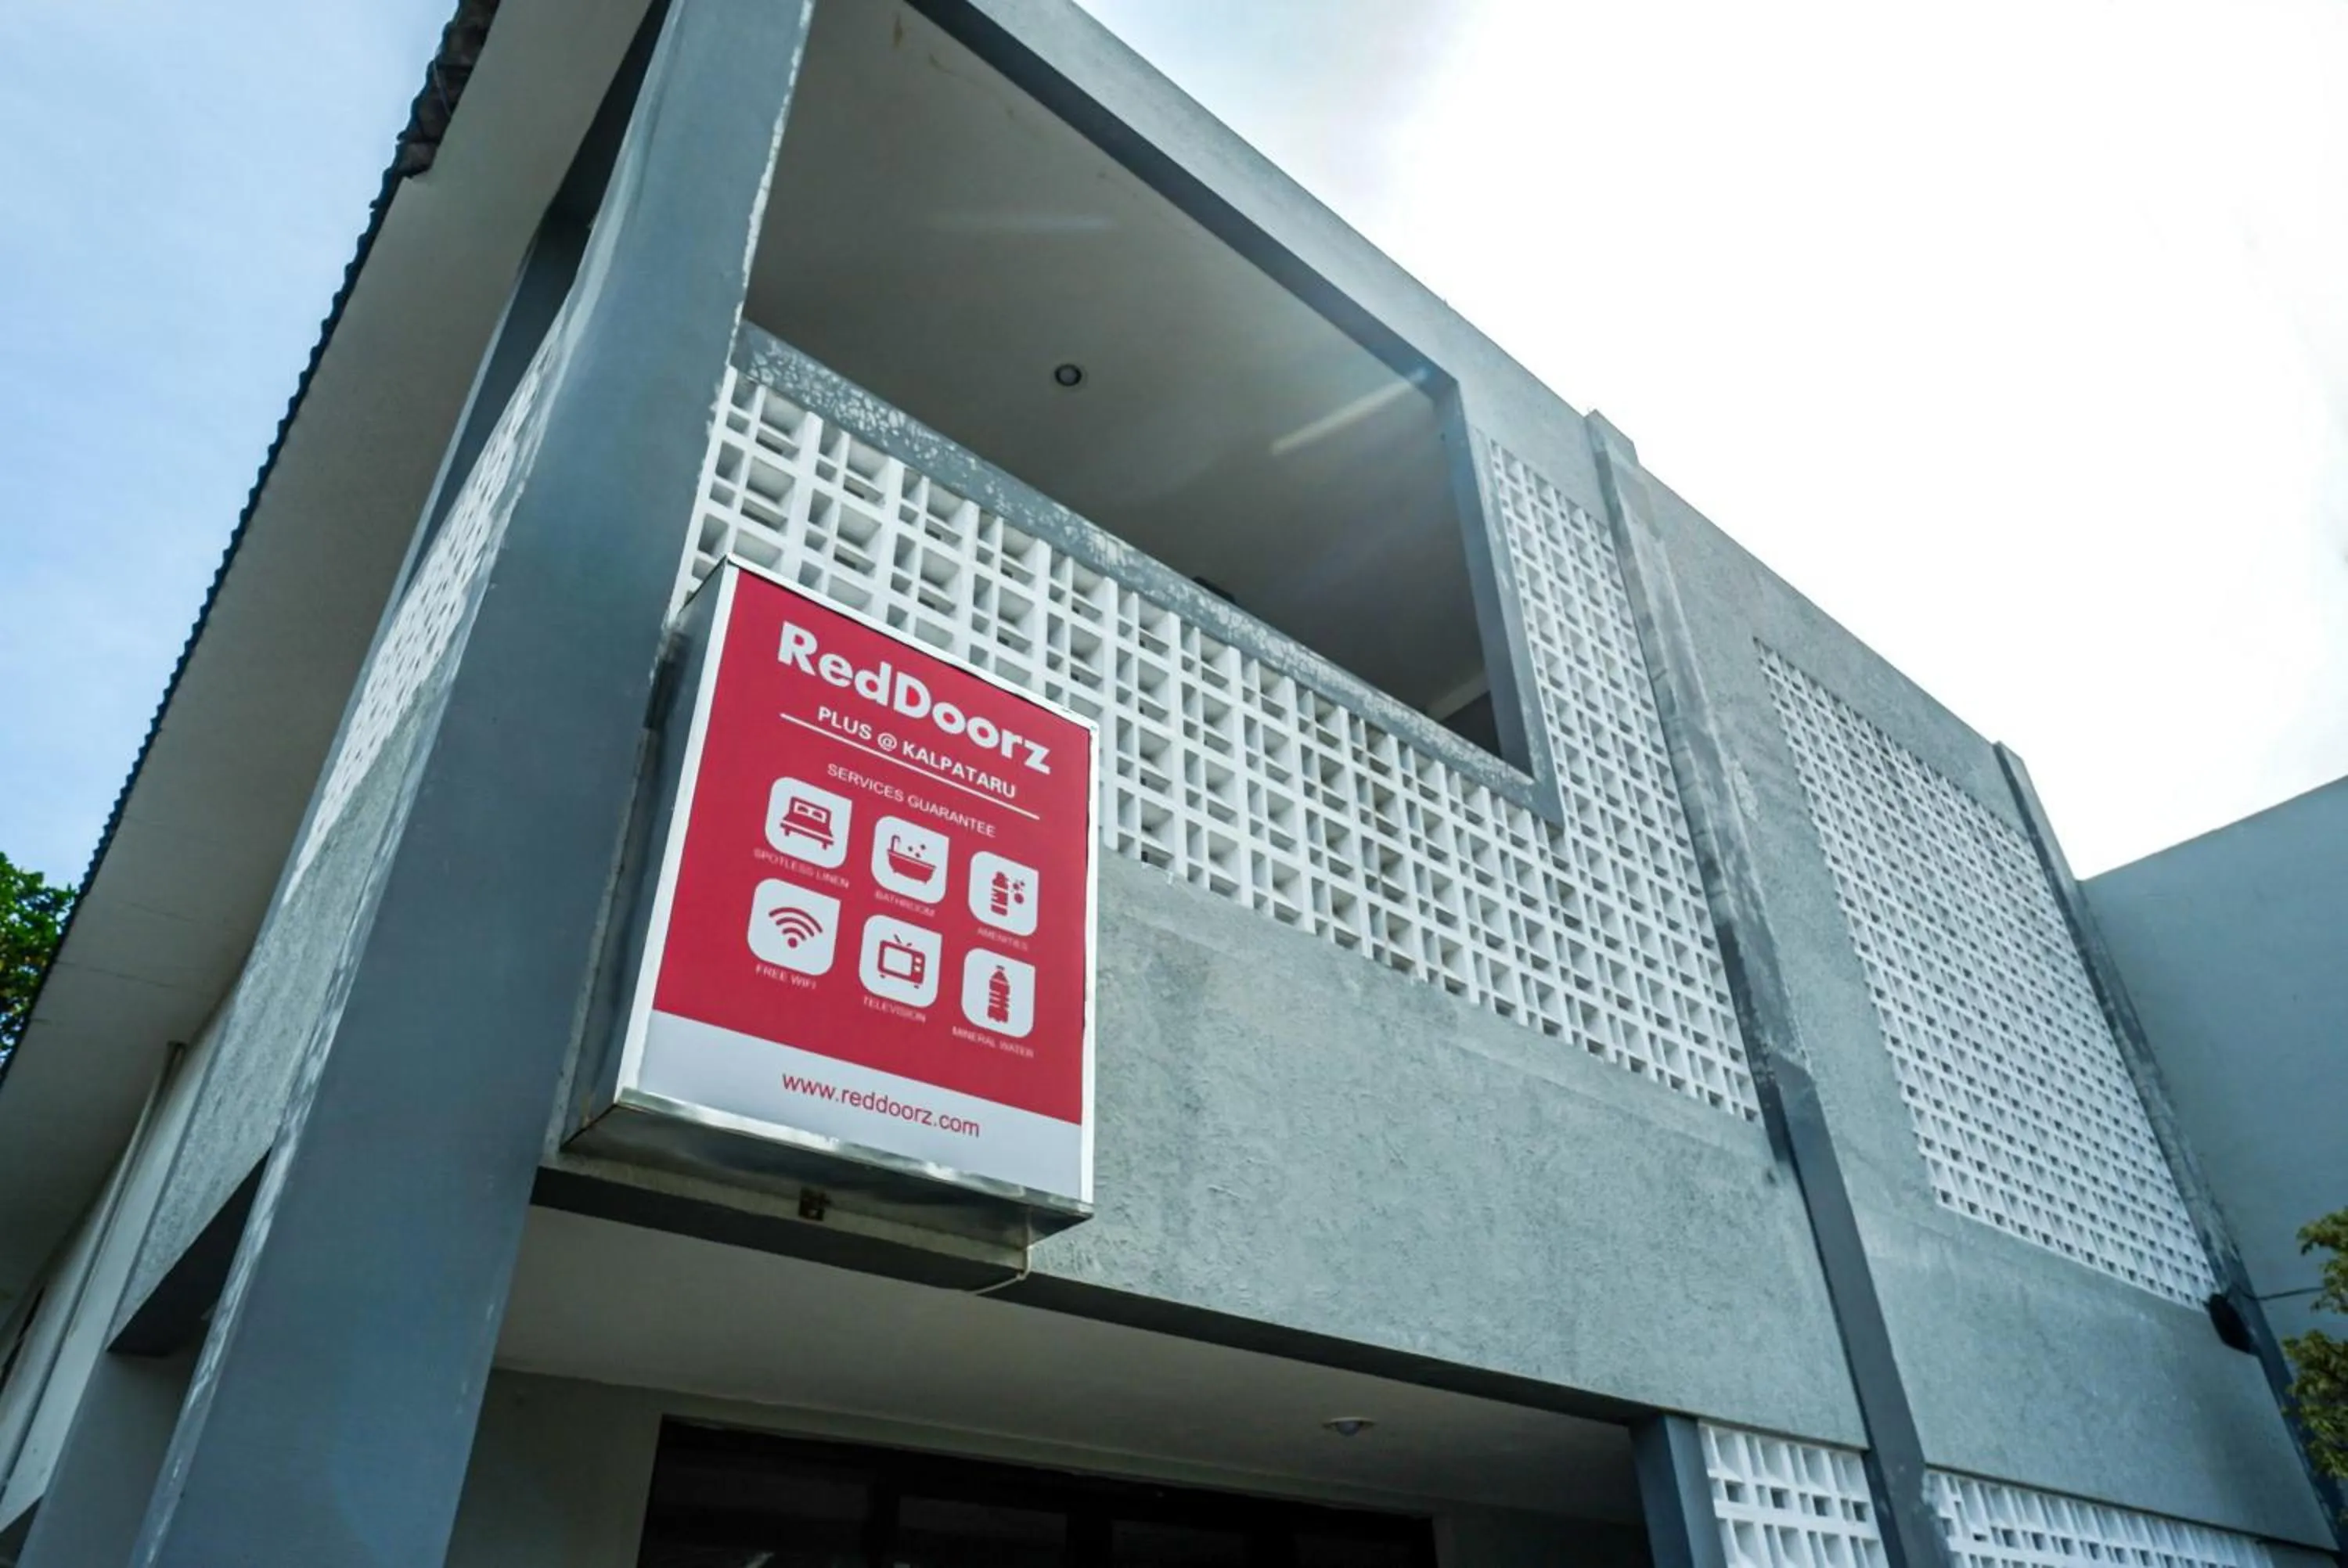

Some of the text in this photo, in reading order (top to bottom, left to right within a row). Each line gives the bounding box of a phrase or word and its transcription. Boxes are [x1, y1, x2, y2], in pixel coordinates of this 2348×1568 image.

[778, 620, 1051, 775] RedDoorz
[818, 706, 1017, 799] PLUS @ KALPATARU
[827, 763, 996, 838] SERVICES GUARANTEE
[755, 963, 817, 991] FREE WIFI
[862, 994, 926, 1023] TELEVISION
[952, 1025, 1035, 1059] MINERAL WATER
[782, 1072, 981, 1138] www.reddoorz.com
